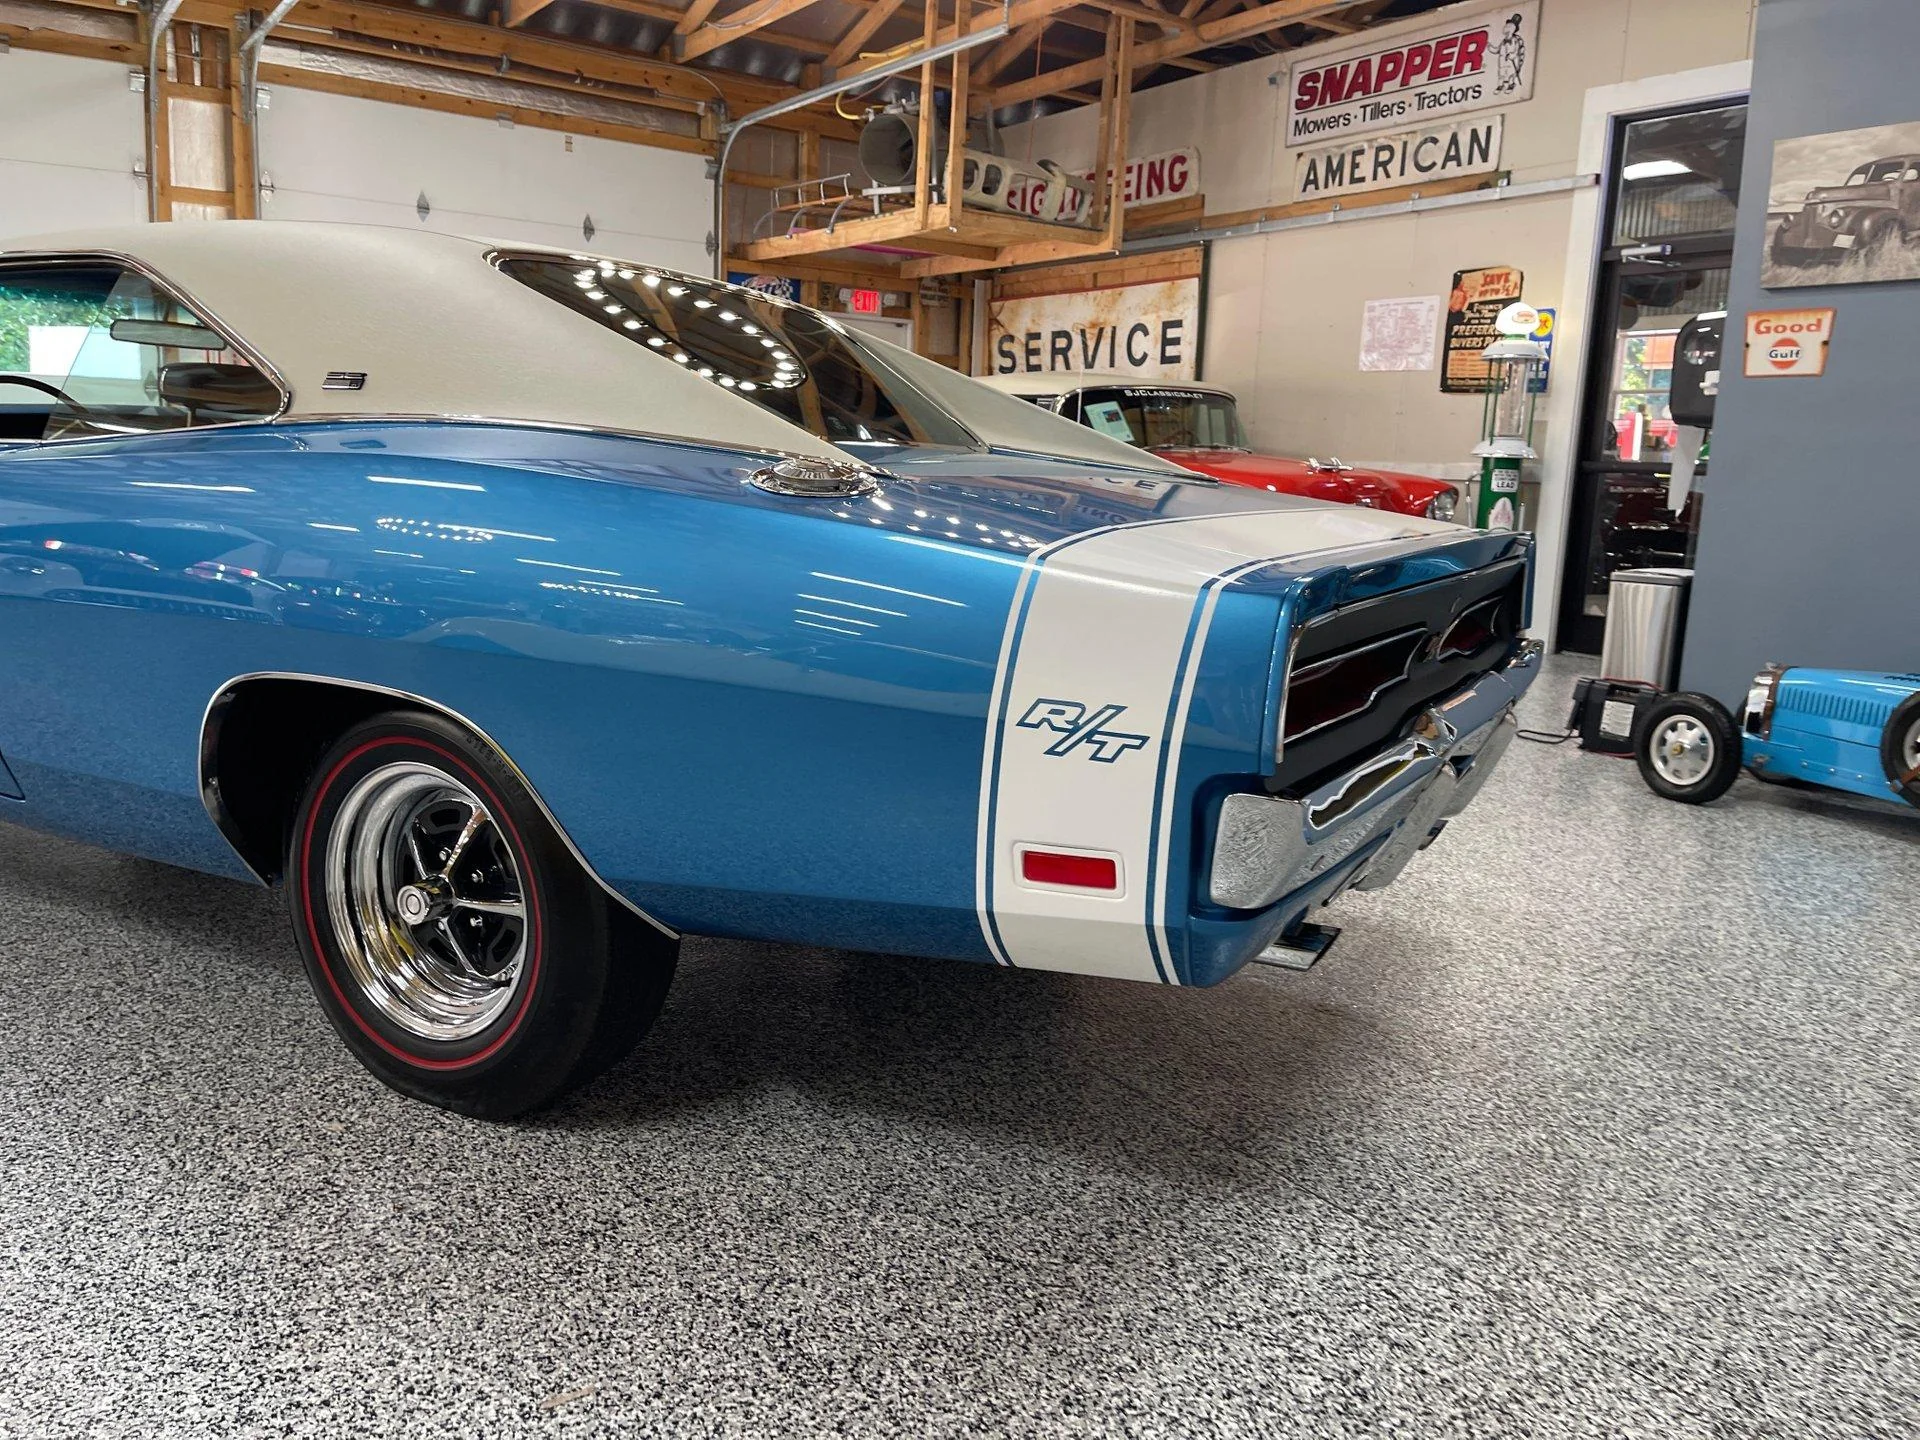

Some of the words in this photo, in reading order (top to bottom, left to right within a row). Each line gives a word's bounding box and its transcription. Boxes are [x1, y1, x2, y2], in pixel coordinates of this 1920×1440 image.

[1295, 30, 1489, 111] SNAPPER
[1294, 113, 1351, 137] Mowers
[1360, 101, 1406, 123] Tillers
[1415, 84, 1482, 112] Tractors
[1301, 125, 1493, 193] AMERICAN
[998, 319, 1183, 374] SERVICE
[1754, 318, 1822, 335] Good
[1769, 349, 1801, 359] Gulf
[1016, 697, 1150, 764] R/T
